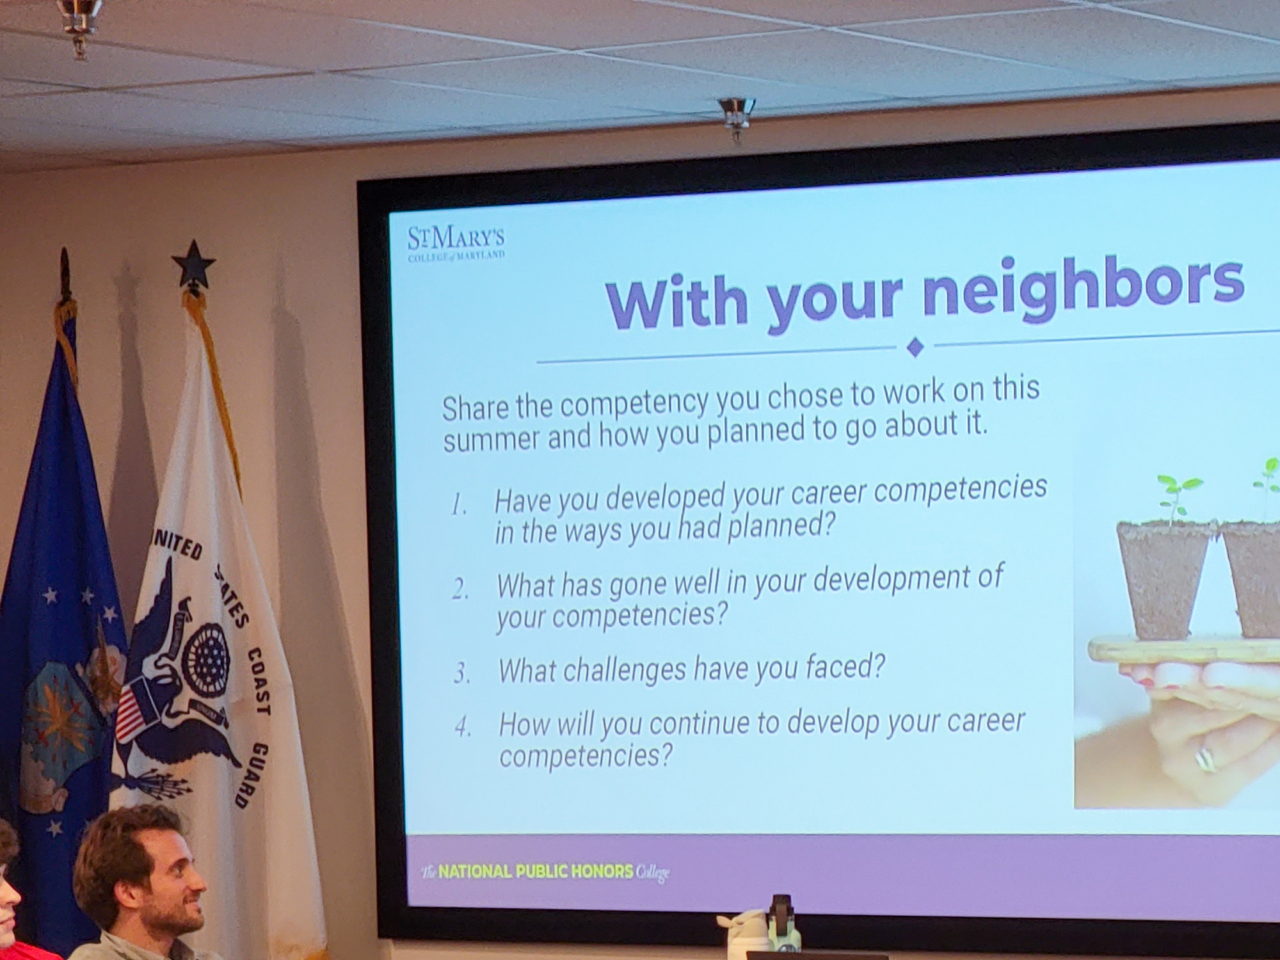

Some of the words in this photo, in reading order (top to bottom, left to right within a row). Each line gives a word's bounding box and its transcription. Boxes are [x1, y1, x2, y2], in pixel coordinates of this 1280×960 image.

[604, 272, 748, 331] With
[766, 277, 904, 338] your
[923, 254, 1246, 326] neighbors
[442, 393, 510, 422] Share
[515, 391, 554, 420] the
[560, 388, 710, 423] competency
[715, 389, 760, 419] you
[767, 381, 844, 411] chose
[849, 380, 876, 408] to
[882, 375, 946, 406] work
[953, 380, 985, 403] on
[992, 371, 1041, 402] this
[443, 429, 541, 454] summer
[548, 419, 591, 450] and
[599, 419, 650, 448] how
[655, 423, 700, 453] you
[707, 412, 805, 451] planned
[811, 414, 838, 441] to
[845, 417, 878, 447] go
[885, 408, 959, 438] about
[966, 406, 988, 435] it.
[450, 491, 468, 516] 1.
[494, 487, 552, 515] Have
[556, 490, 600, 520] you
[605, 479, 727, 521] developed
[730, 485, 786, 515] your
[791, 483, 868, 506] career
[874, 472, 1048, 509] competencies
[150, 528, 203, 561] NITED
[495, 519, 514, 545] in
[521, 516, 558, 544] the
[564, 521, 623, 550] ways
[627, 520, 672, 549] you
[677, 511, 723, 541] had
[727, 508, 837, 546] planned?
[451, 576, 470, 601] 2.
[497, 571, 556, 599] What
[561, 570, 603, 598] has
[609, 575, 668, 603] gone
[674, 566, 721, 596] well
[726, 568, 747, 595] in
[752, 572, 808, 601] your
[813, 562, 972, 598] development
[978, 560, 1007, 589] of
[495, 608, 548, 637] your
[552, 599, 729, 635] competencies?
[247, 646, 272, 717] COAST
[452, 660, 471, 685] 3.
[499, 656, 558, 684] What
[563, 654, 687, 688] challenges
[693, 653, 749, 682] have
[754, 659, 799, 688] you
[806, 650, 886, 680] faced?
[453, 713, 472, 740] 4.
[499, 711, 552, 737] How
[557, 708, 596, 737] will
[599, 716, 643, 744] you
[649, 709, 750, 736] continue
[757, 711, 780, 735] to
[787, 706, 880, 741] develop
[885, 712, 942, 741] your
[947, 711, 1027, 733] career
[234, 742, 270, 810] GUARD
[499, 741, 674, 775] competencies?
[437, 863, 513, 879] NATIONAL
[515, 863, 569, 879] PUBLIC
[571, 863, 634, 879] HONORS
[635, 864, 671, 885] College
